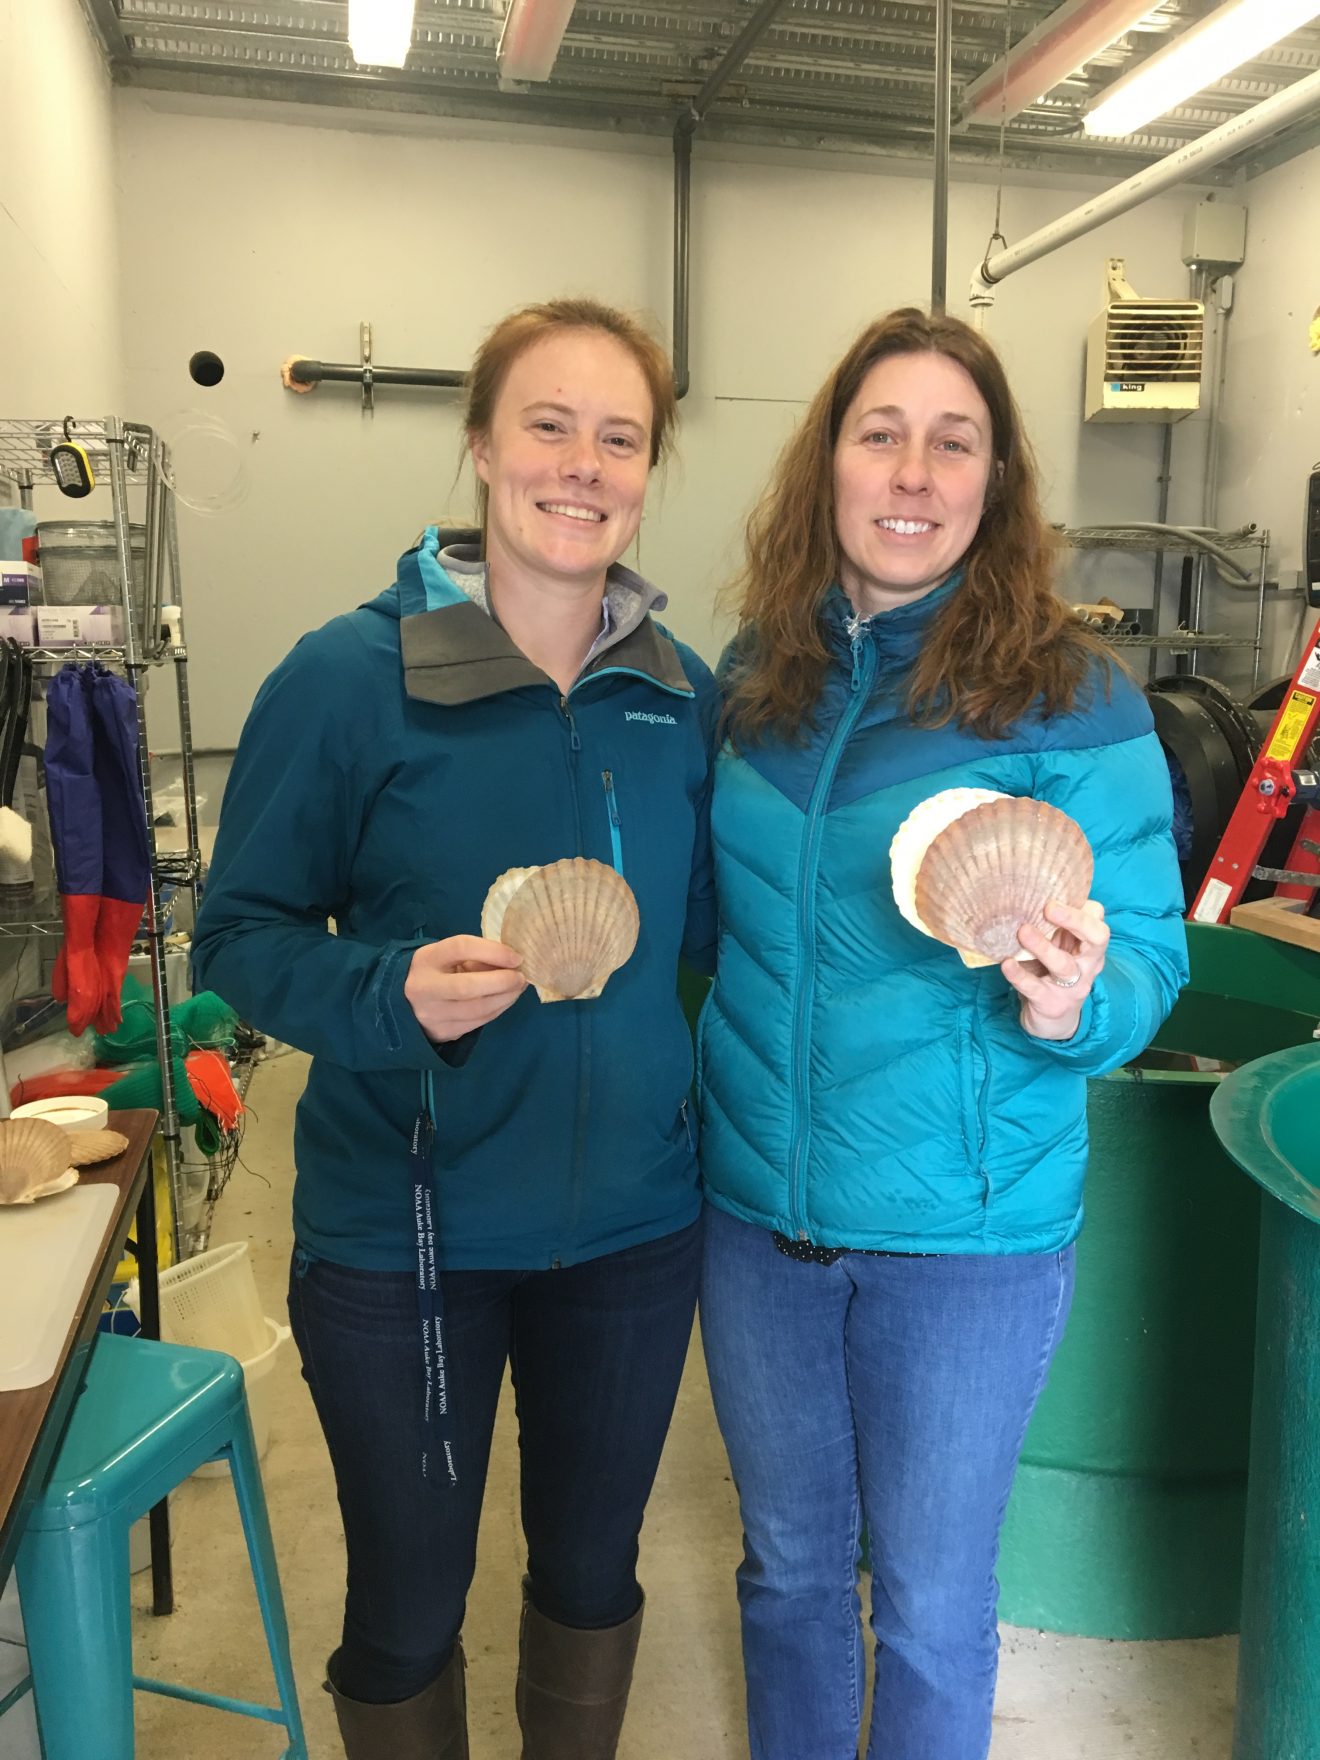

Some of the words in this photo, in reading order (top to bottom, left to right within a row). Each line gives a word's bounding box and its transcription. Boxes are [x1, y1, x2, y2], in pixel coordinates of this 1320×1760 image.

[624, 711, 678, 724] patagonia
[414, 1184, 423, 1211] NOAA
[416, 1212, 424, 1231] Auke
[416, 1232, 425, 1247] Bay
[418, 1248, 426, 1290] Laboratory
[422, 1319, 430, 1344] NOAA
[434, 1316, 443, 1354] Laboratory
[437, 1355, 446, 1368] Bay
[437, 1369, 446, 1389] Auke
[439, 1390, 448, 1415] NOAA
[443, 1440, 457, 1481] Laboratory
